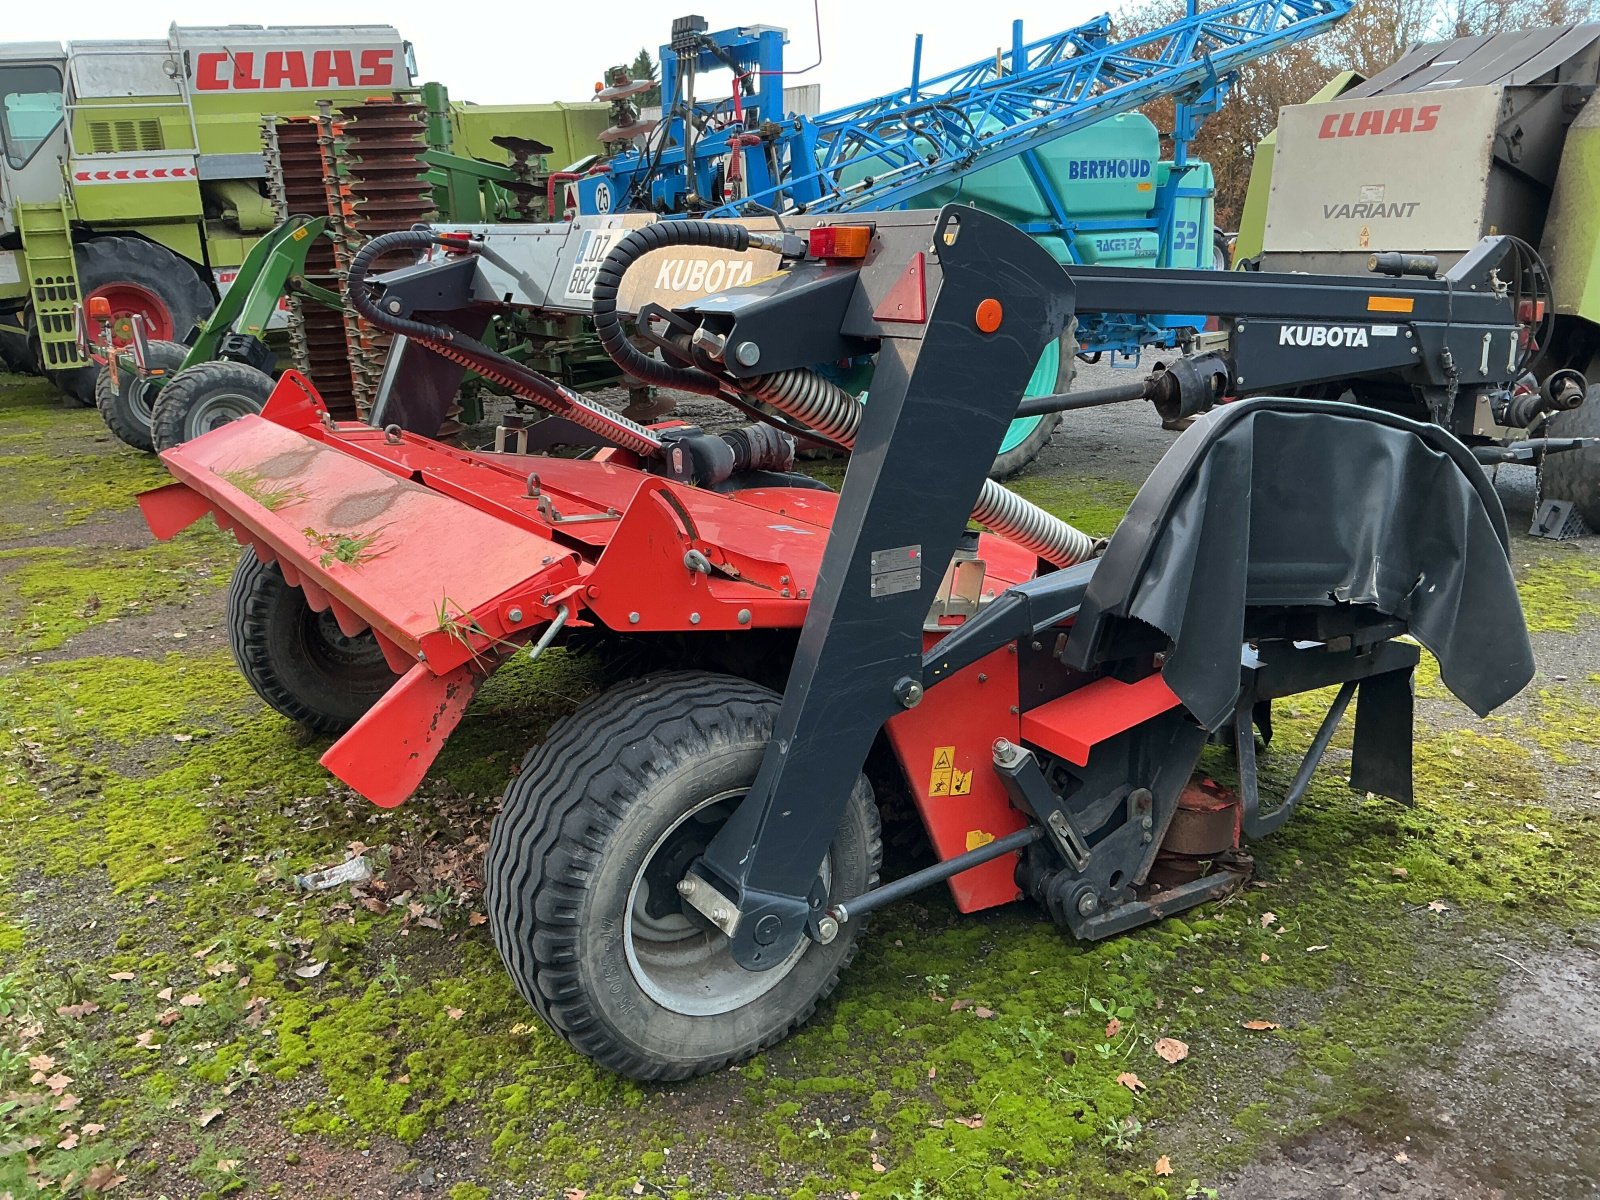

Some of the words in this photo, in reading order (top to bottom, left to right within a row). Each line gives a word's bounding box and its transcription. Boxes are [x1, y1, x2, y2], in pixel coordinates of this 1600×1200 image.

[196, 49, 394, 91] CLAAS
[1318, 105, 1442, 139] CLAAS
[1069, 159, 1151, 180] BERTHOUD
[597, 186, 609, 211] 25
[1323, 202, 1420, 219] VARIANT
[654, 259, 753, 293] KUBOTA
[1279, 325, 1369, 348] KUBOTA
